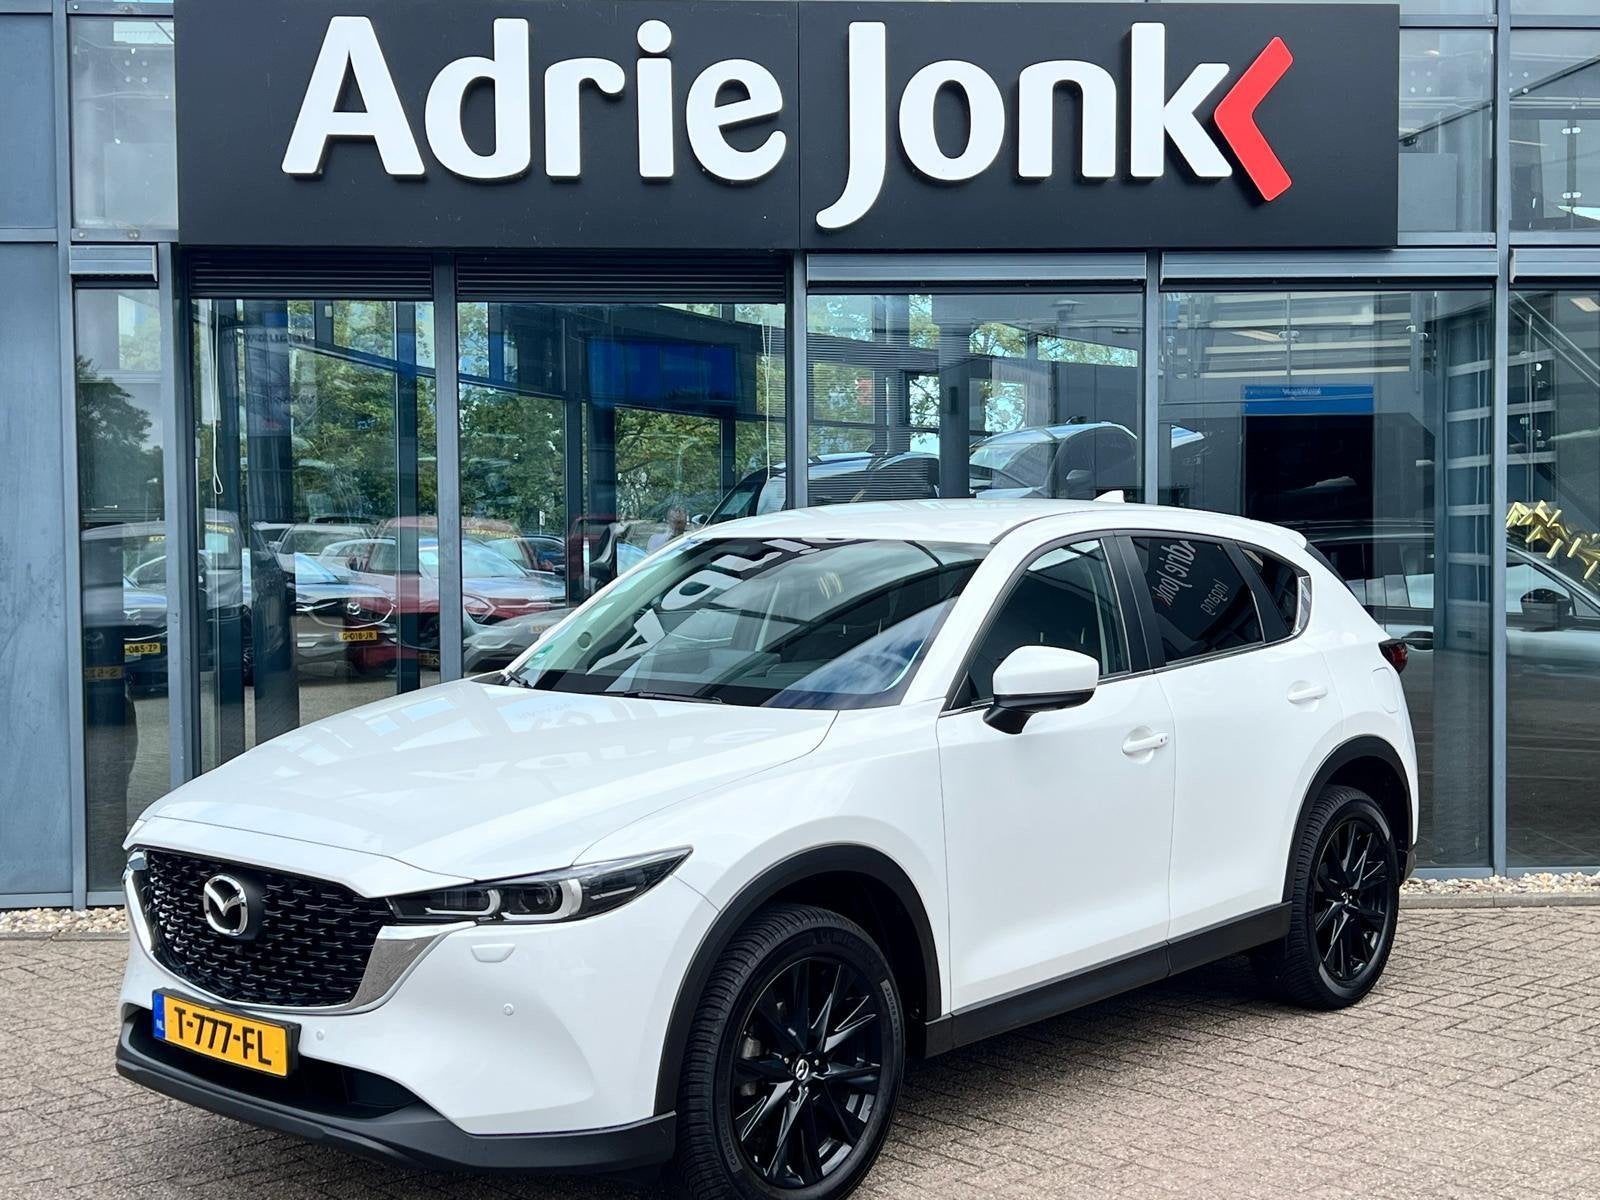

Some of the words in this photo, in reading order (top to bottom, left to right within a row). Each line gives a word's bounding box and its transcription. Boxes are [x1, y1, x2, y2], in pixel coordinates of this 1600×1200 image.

[281, 16, 787, 181] Adrie
[816, 22, 1233, 229] Jonk
[175, 1007, 272, 1066] T-777-FL
